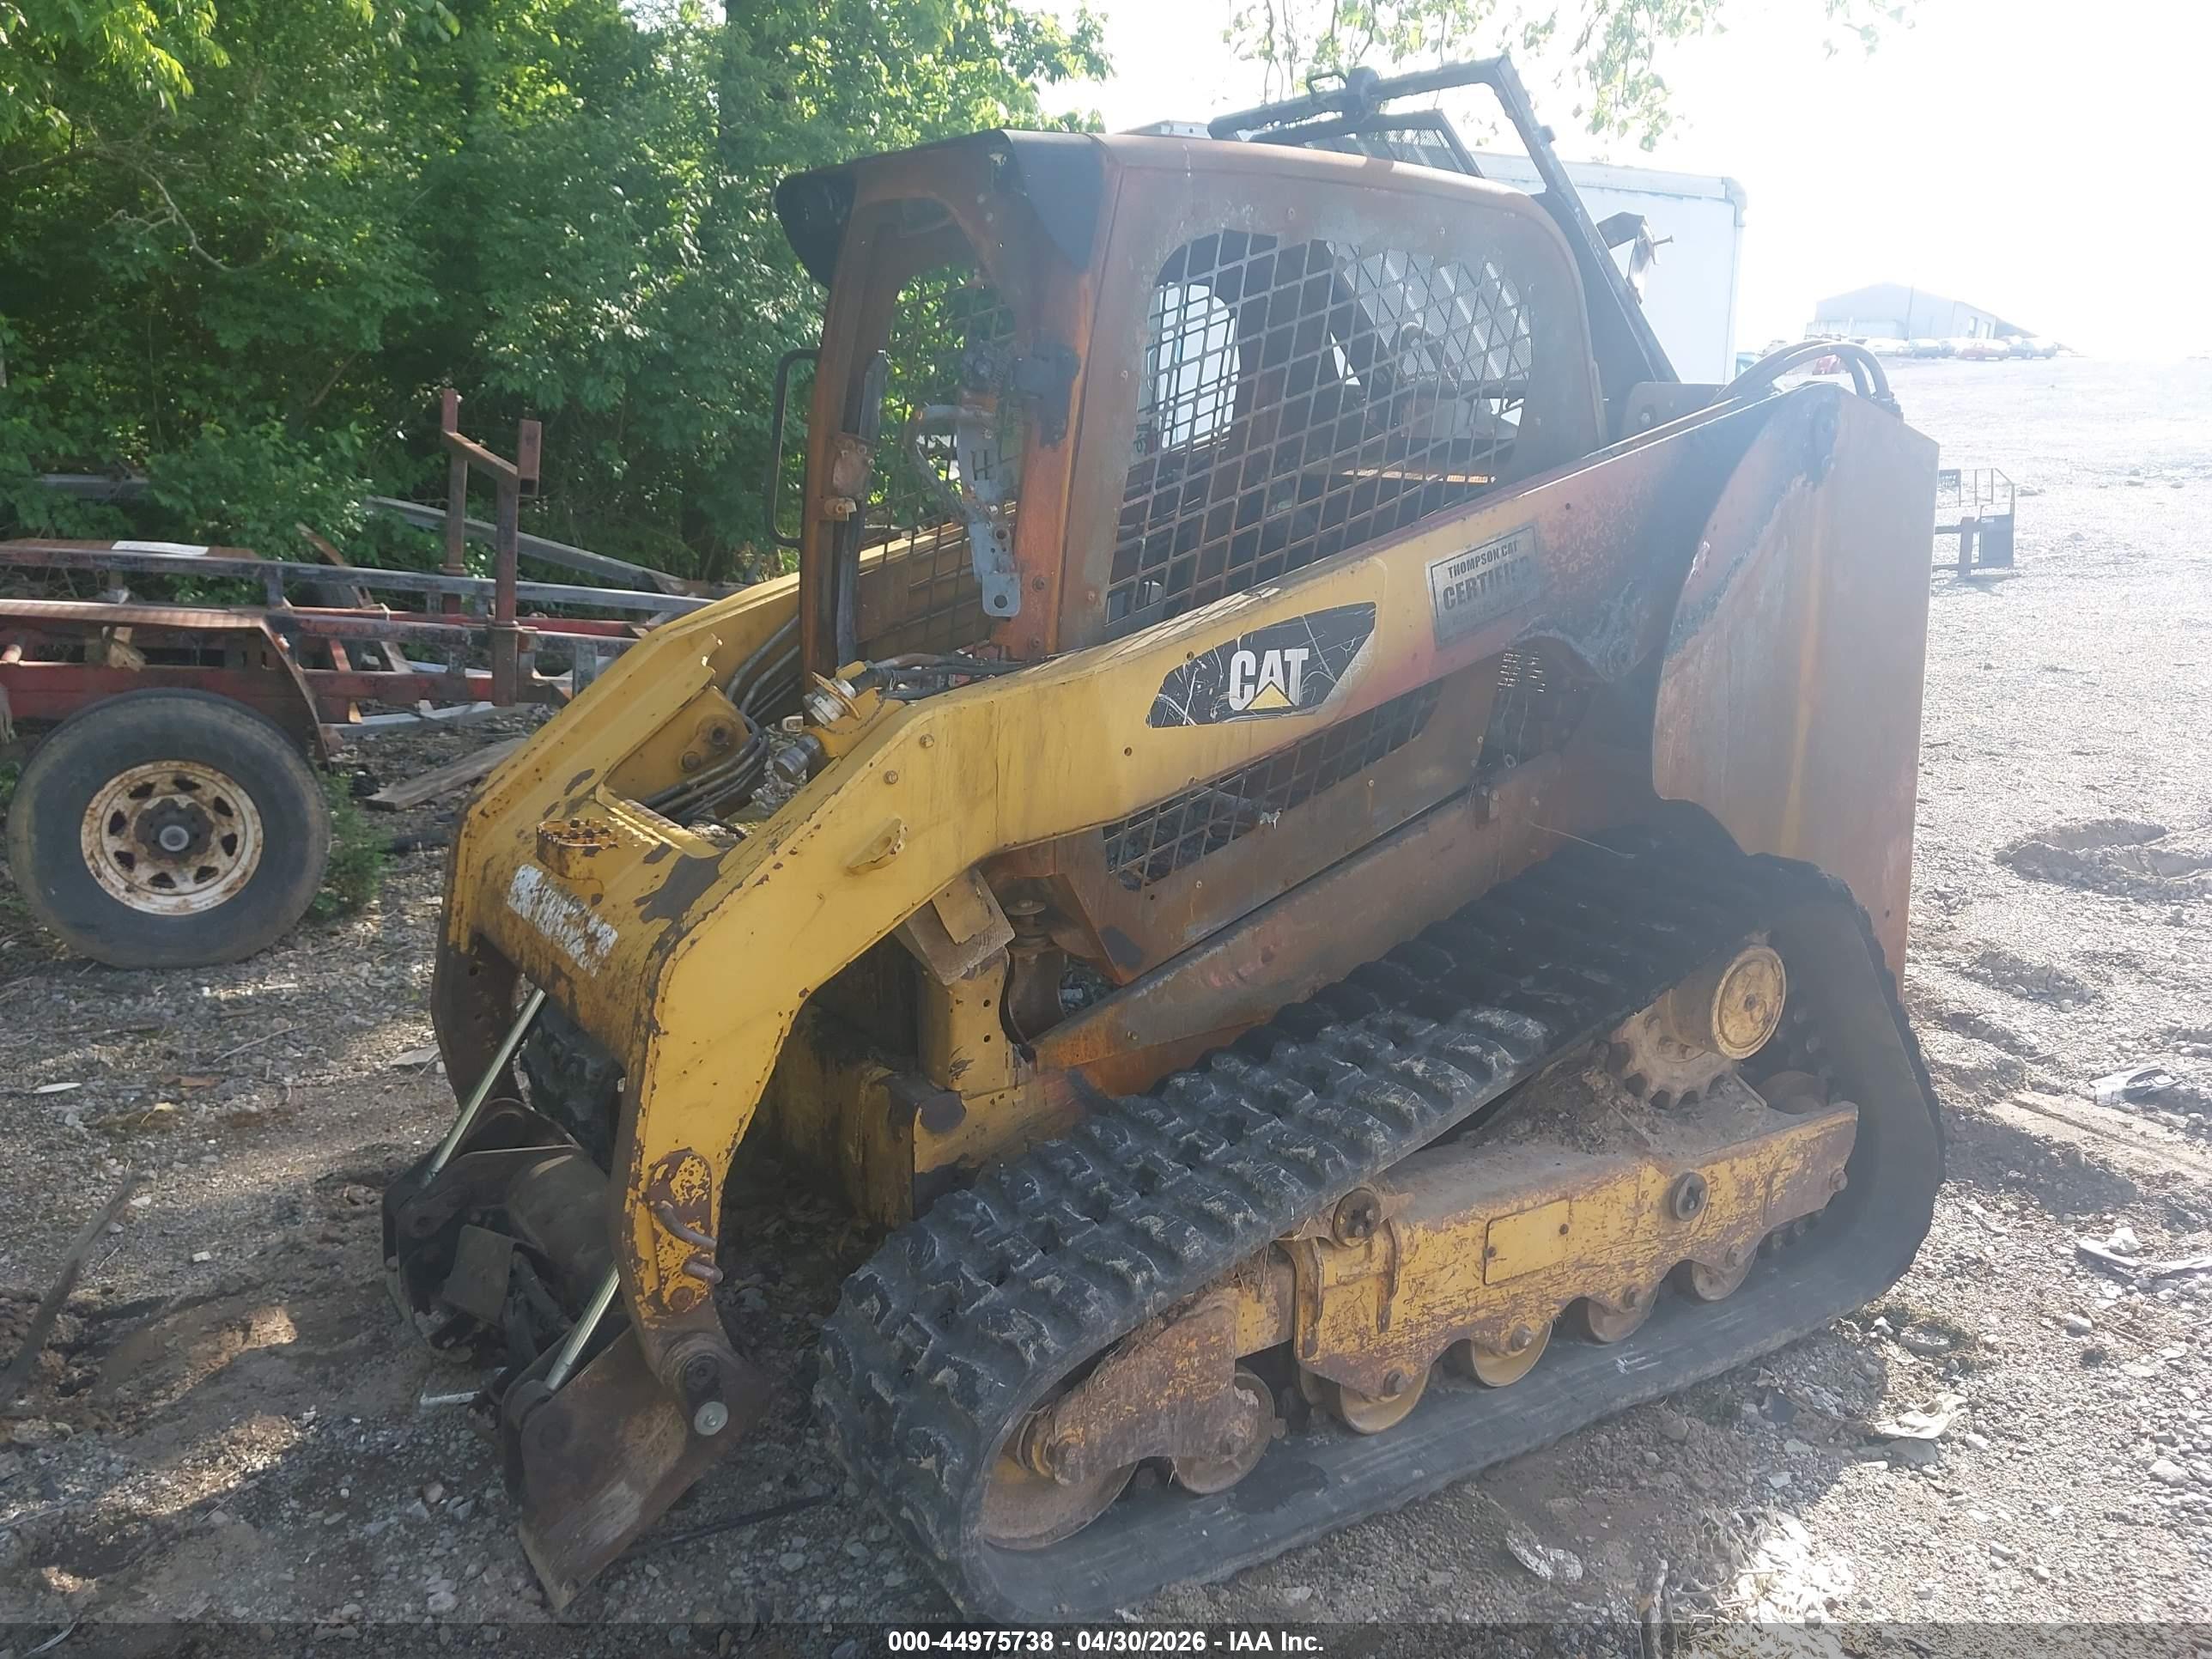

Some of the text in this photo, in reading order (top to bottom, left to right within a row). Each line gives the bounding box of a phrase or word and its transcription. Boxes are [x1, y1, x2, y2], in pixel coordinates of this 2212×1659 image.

[1448, 540, 1518, 579] THOMPSON CAT
[1230, 648, 1309, 710] CAT
